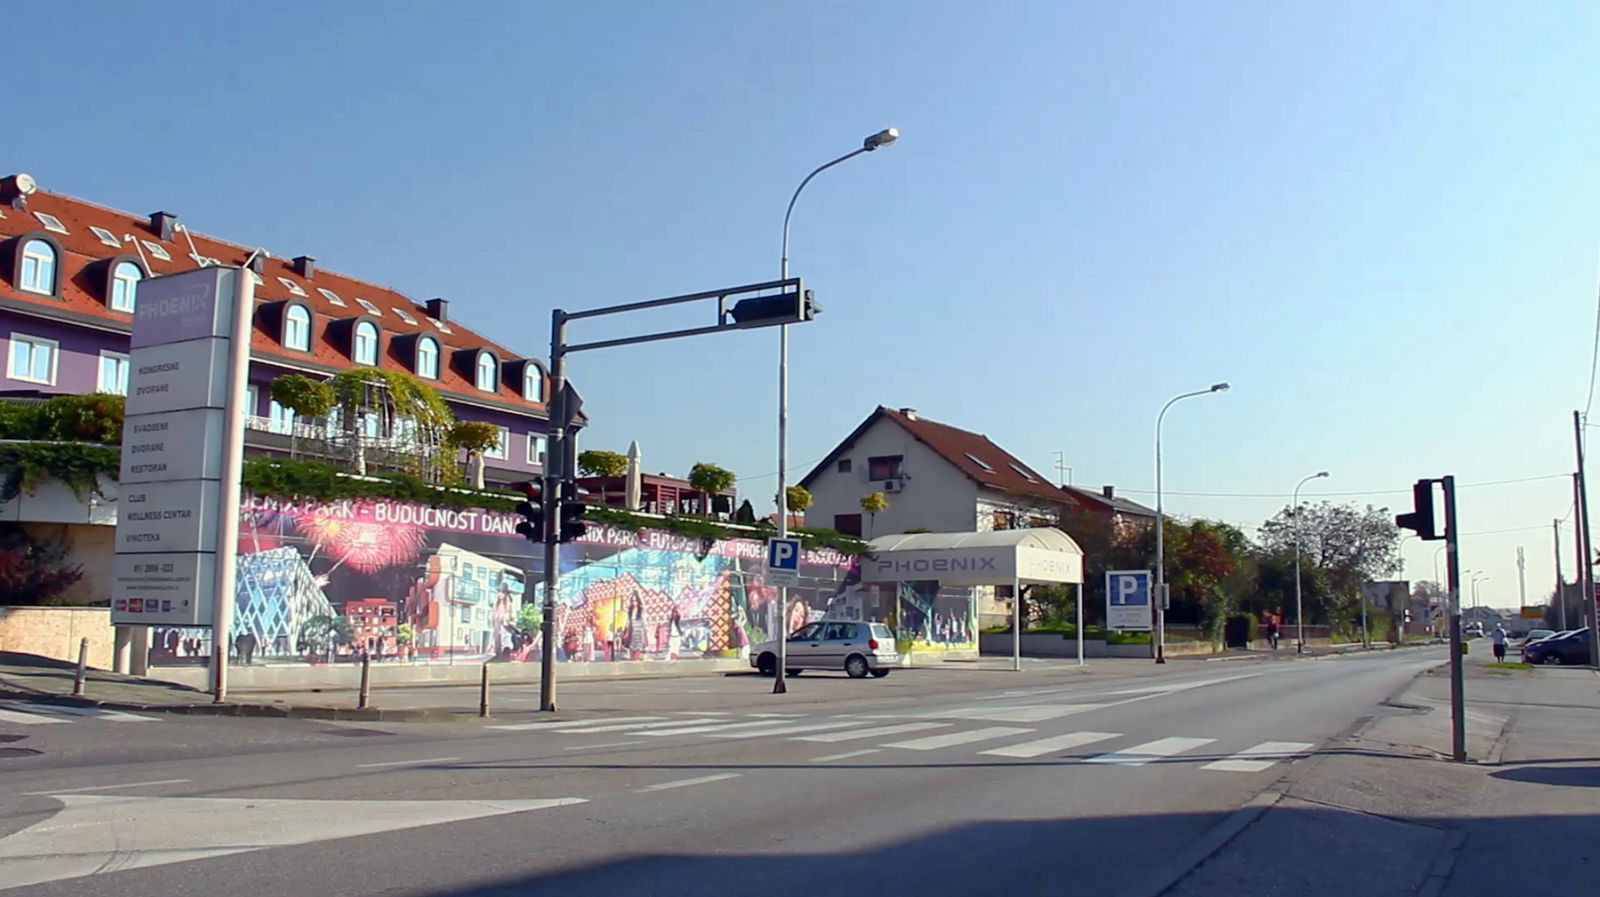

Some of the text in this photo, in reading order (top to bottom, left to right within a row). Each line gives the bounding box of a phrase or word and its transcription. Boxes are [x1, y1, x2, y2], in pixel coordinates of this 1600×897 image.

[139, 294, 207, 320] PHOENIX
[136, 383, 169, 396] DVORANE
[131, 442, 164, 454] DVORANE
[130, 463, 168, 473] RESTORAN
[128, 494, 146, 503] CLUB
[163, 509, 192, 519] CENTAR
[481, 513, 528, 535] DANA
[774, 542, 793, 567] P
[1118, 576, 1138, 604] P
